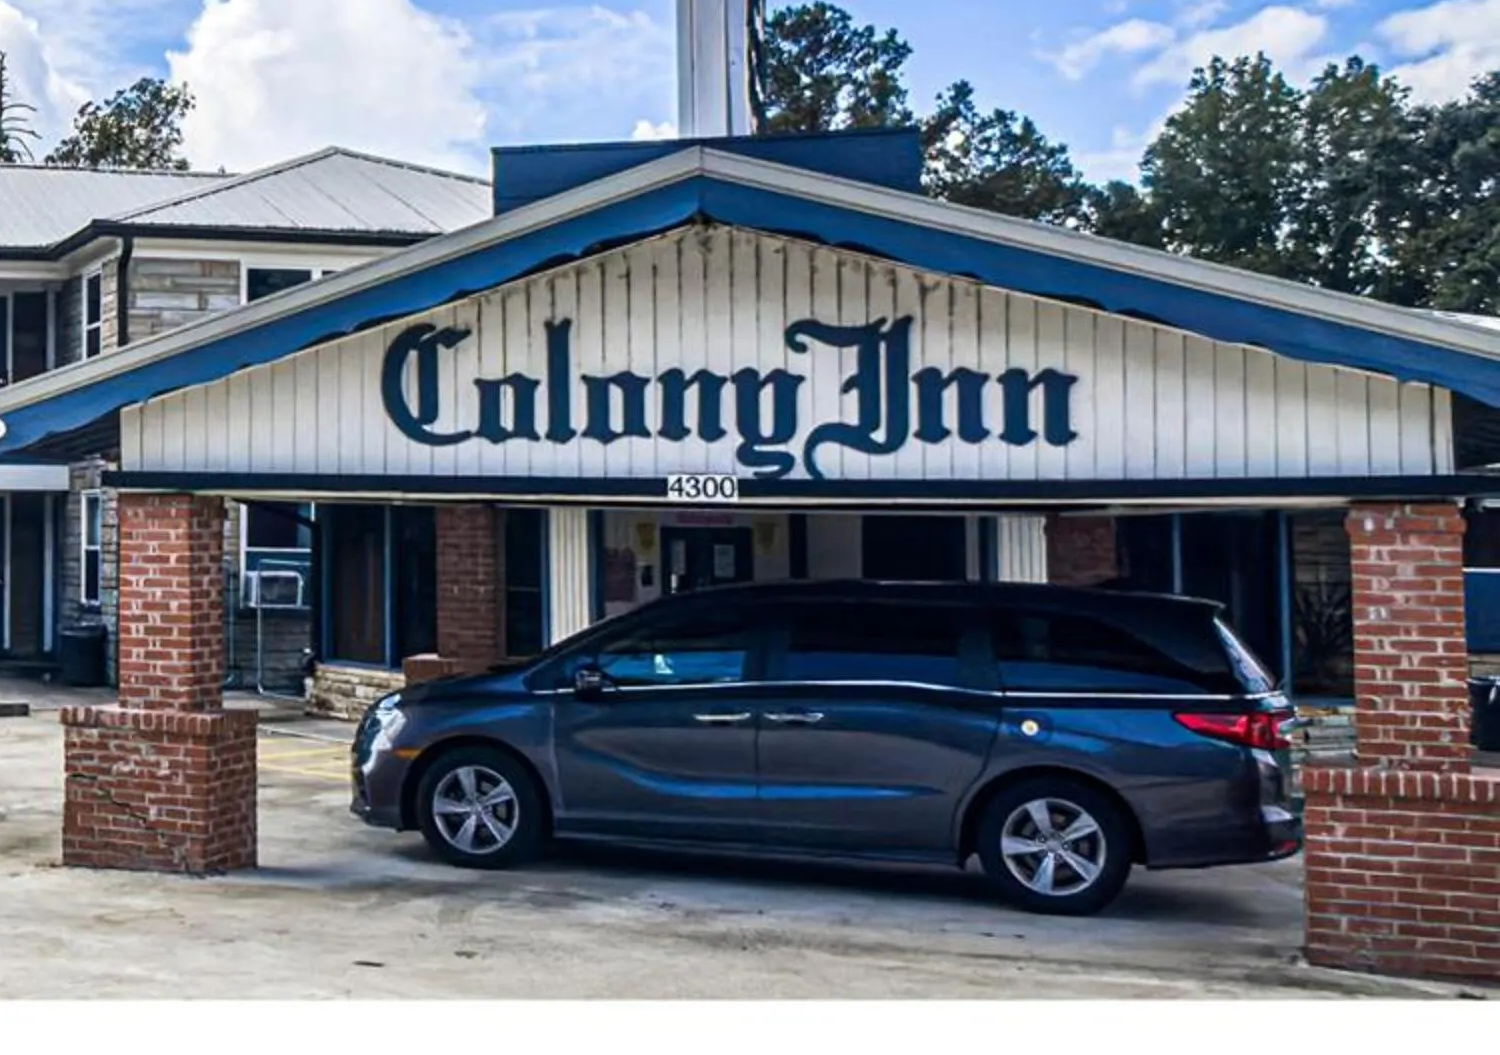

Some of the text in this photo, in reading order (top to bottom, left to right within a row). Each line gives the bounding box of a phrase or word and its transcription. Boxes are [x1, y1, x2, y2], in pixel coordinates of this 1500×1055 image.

[381, 315, 1078, 479] Colony Inn
[669, 476, 735, 499] 4300
